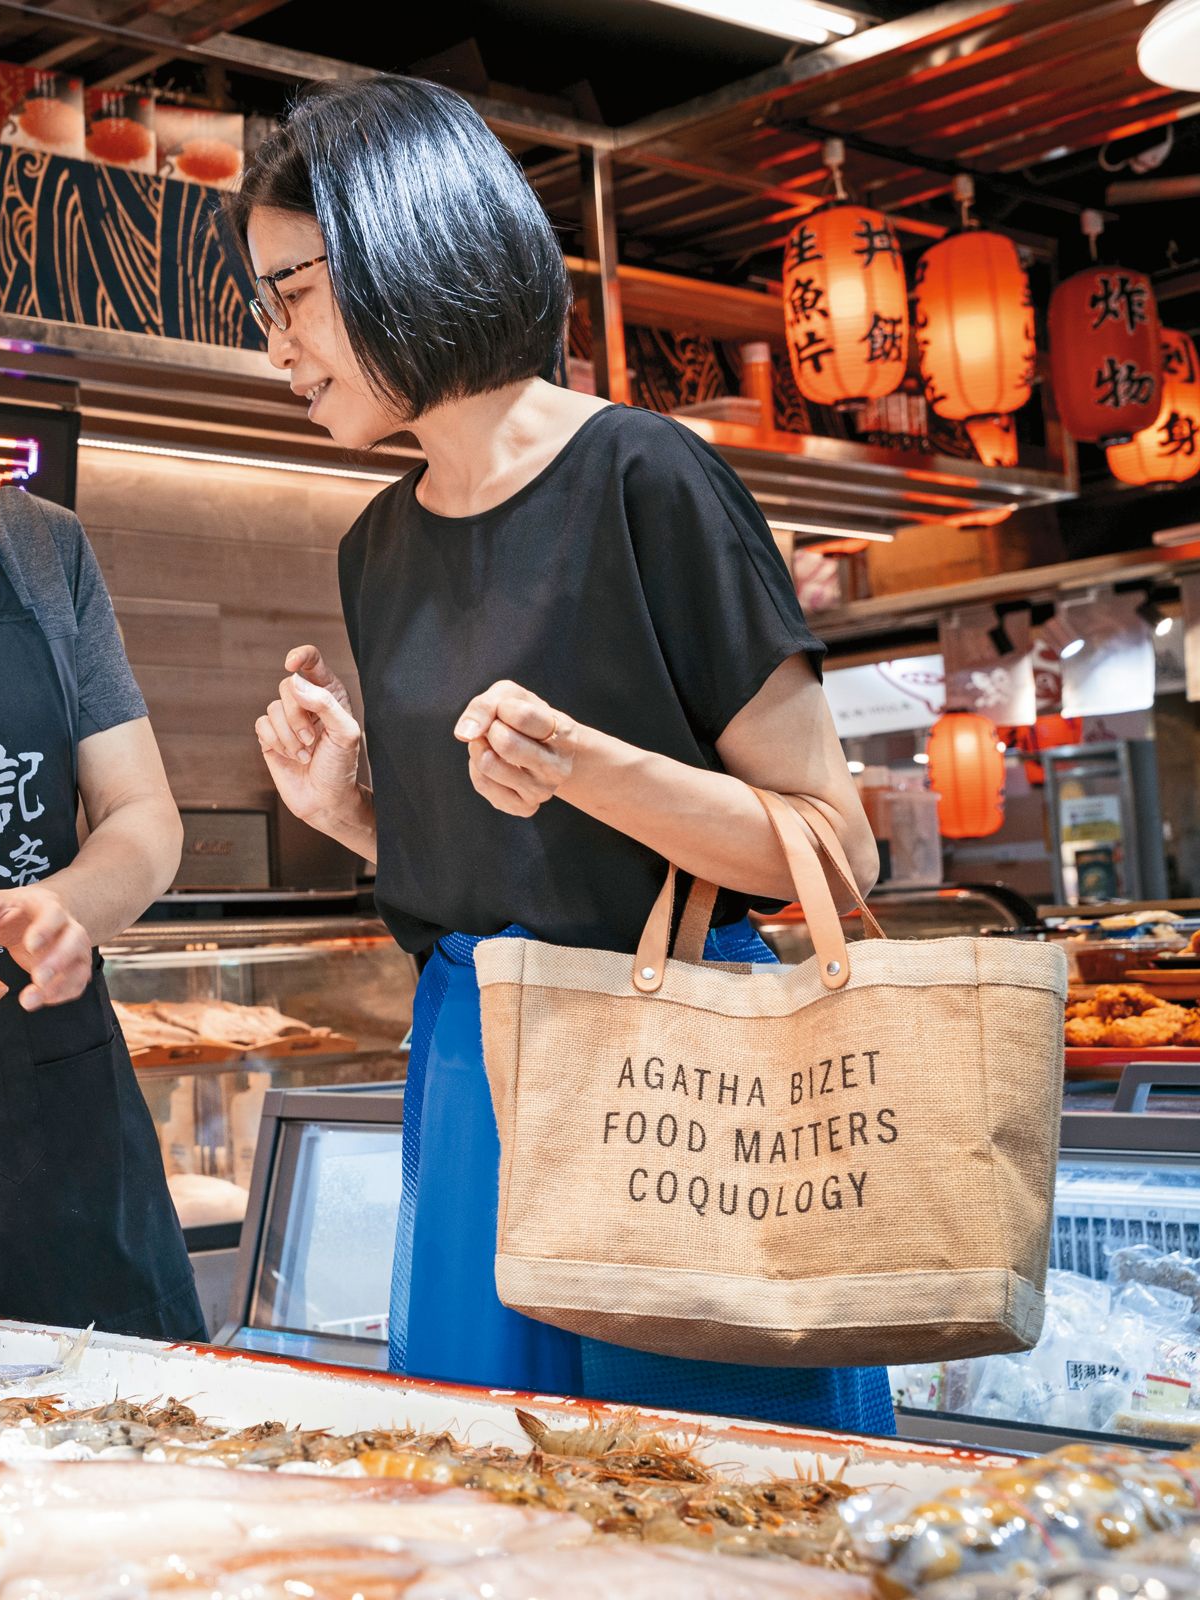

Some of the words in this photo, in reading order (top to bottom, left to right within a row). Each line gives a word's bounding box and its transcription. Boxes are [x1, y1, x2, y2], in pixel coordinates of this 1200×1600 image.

[787, 224, 834, 373] 生魚片
[1090, 277, 1155, 409] 炸物
[617, 1056, 766, 1108] AGATHA
[790, 1049, 881, 1106] BIZET
[603, 1110, 707, 1154] FOOD
[734, 1108, 899, 1165] MATTERS
[628, 1167, 869, 1221] COQUOLOGY
